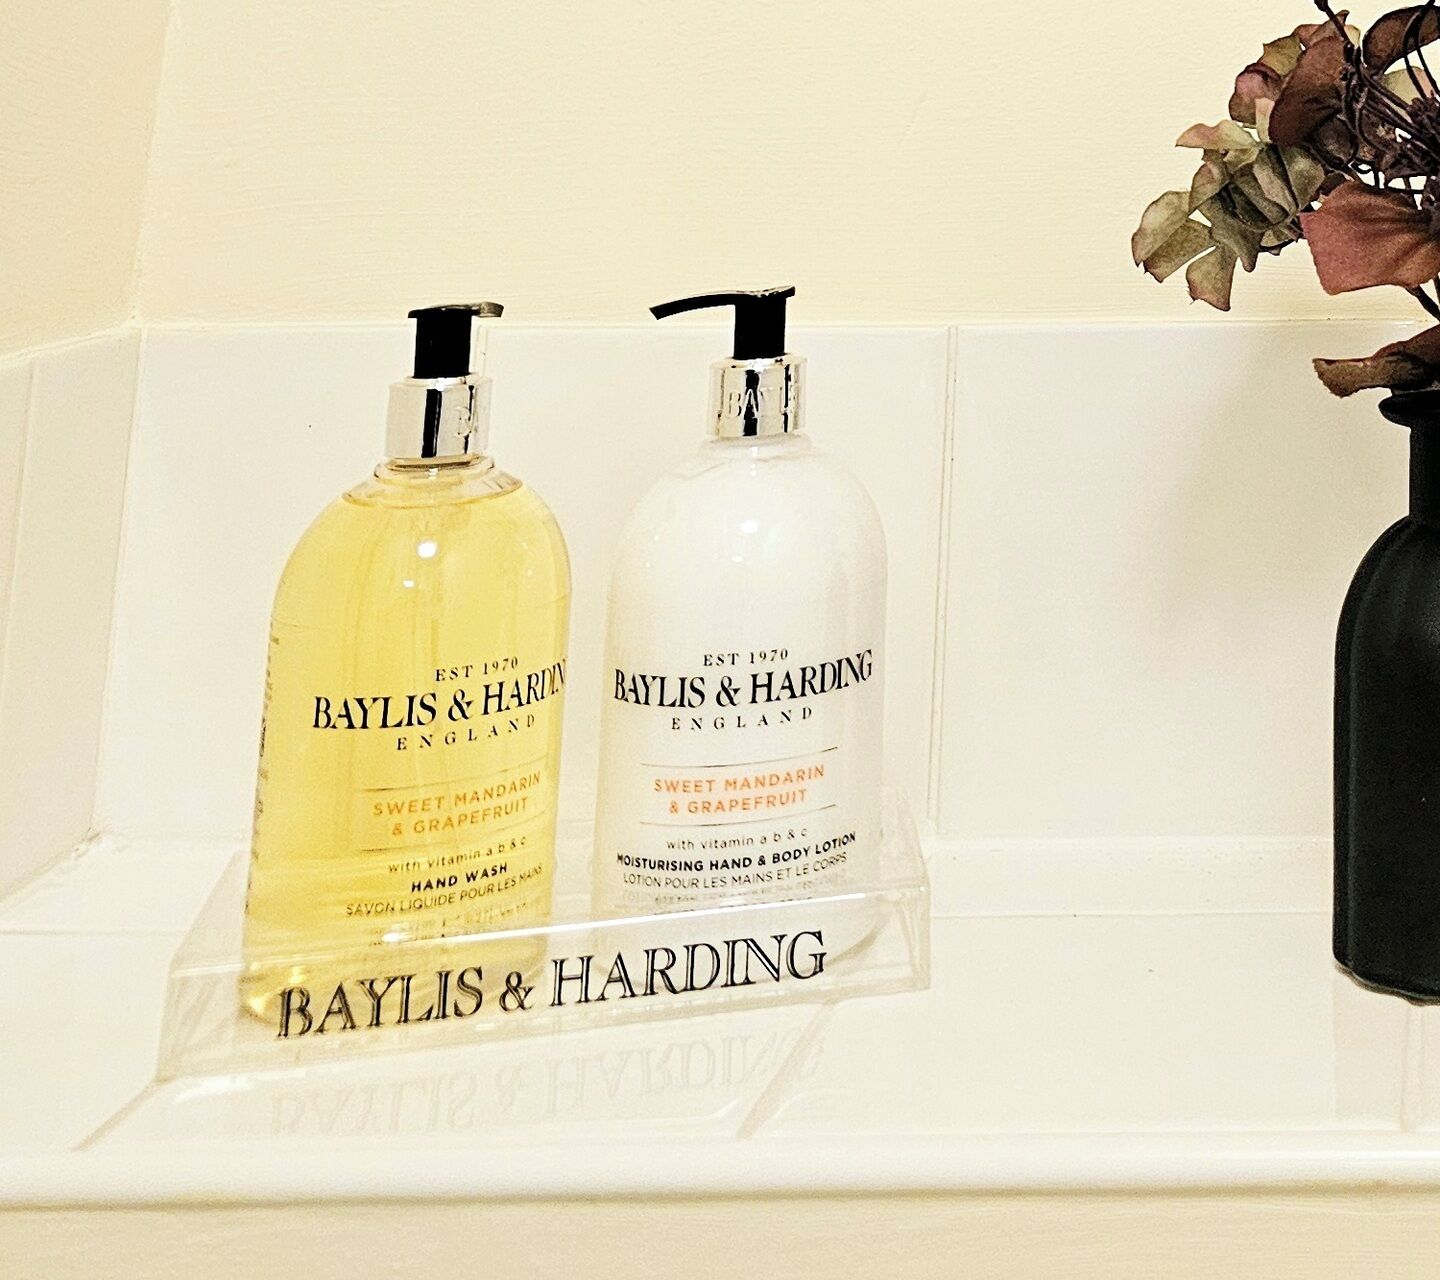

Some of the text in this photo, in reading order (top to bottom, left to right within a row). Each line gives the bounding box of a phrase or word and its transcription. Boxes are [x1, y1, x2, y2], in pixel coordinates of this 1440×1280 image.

[436, 656, 519, 682] EST 1970
[703, 648, 788, 667] EST 1970
[312, 658, 568, 730] BAYLIS & HARDIN
[613, 648, 872, 709] BAYLIS & HARDING
[396, 714, 535, 751] ENGLAND
[671, 707, 812, 730] ENGLAND
[373, 770, 542, 817] SWEET MANDARIN
[654, 763, 825, 794] SWEET MANDARIN
[392, 796, 529, 836] & GRAPEFRUIT
[669, 789, 808, 815] & GRAPEFRUIT
[388, 857, 421, 873] with
[428, 849, 481, 869] vitamin
[486, 847, 493, 856] a
[498, 840, 505, 853] b
[617, 831, 856, 872] MOISTURISING HAND & BODY LOTION
[666, 838, 695, 851] with
[700, 834, 754, 850] vitamin
[760, 835, 767, 845] a
[773, 831, 781, 842] b
[411, 862, 508, 893] HAND WASH
[623, 873, 661, 888] LOTION
[665, 876, 699, 889] POUR
[703, 876, 727, 889] LES
[731, 870, 773, 887] MAINS
[777, 866, 791, 880] ET
[796, 862, 810, 877] LE
[346, 901, 396, 917] SAVON
[400, 892, 456, 912] LIQUIDE
[460, 883, 494, 901] POUR
[497, 874, 517, 893] LES
[276, 929, 828, 1039] BAYLIS & HARDING
